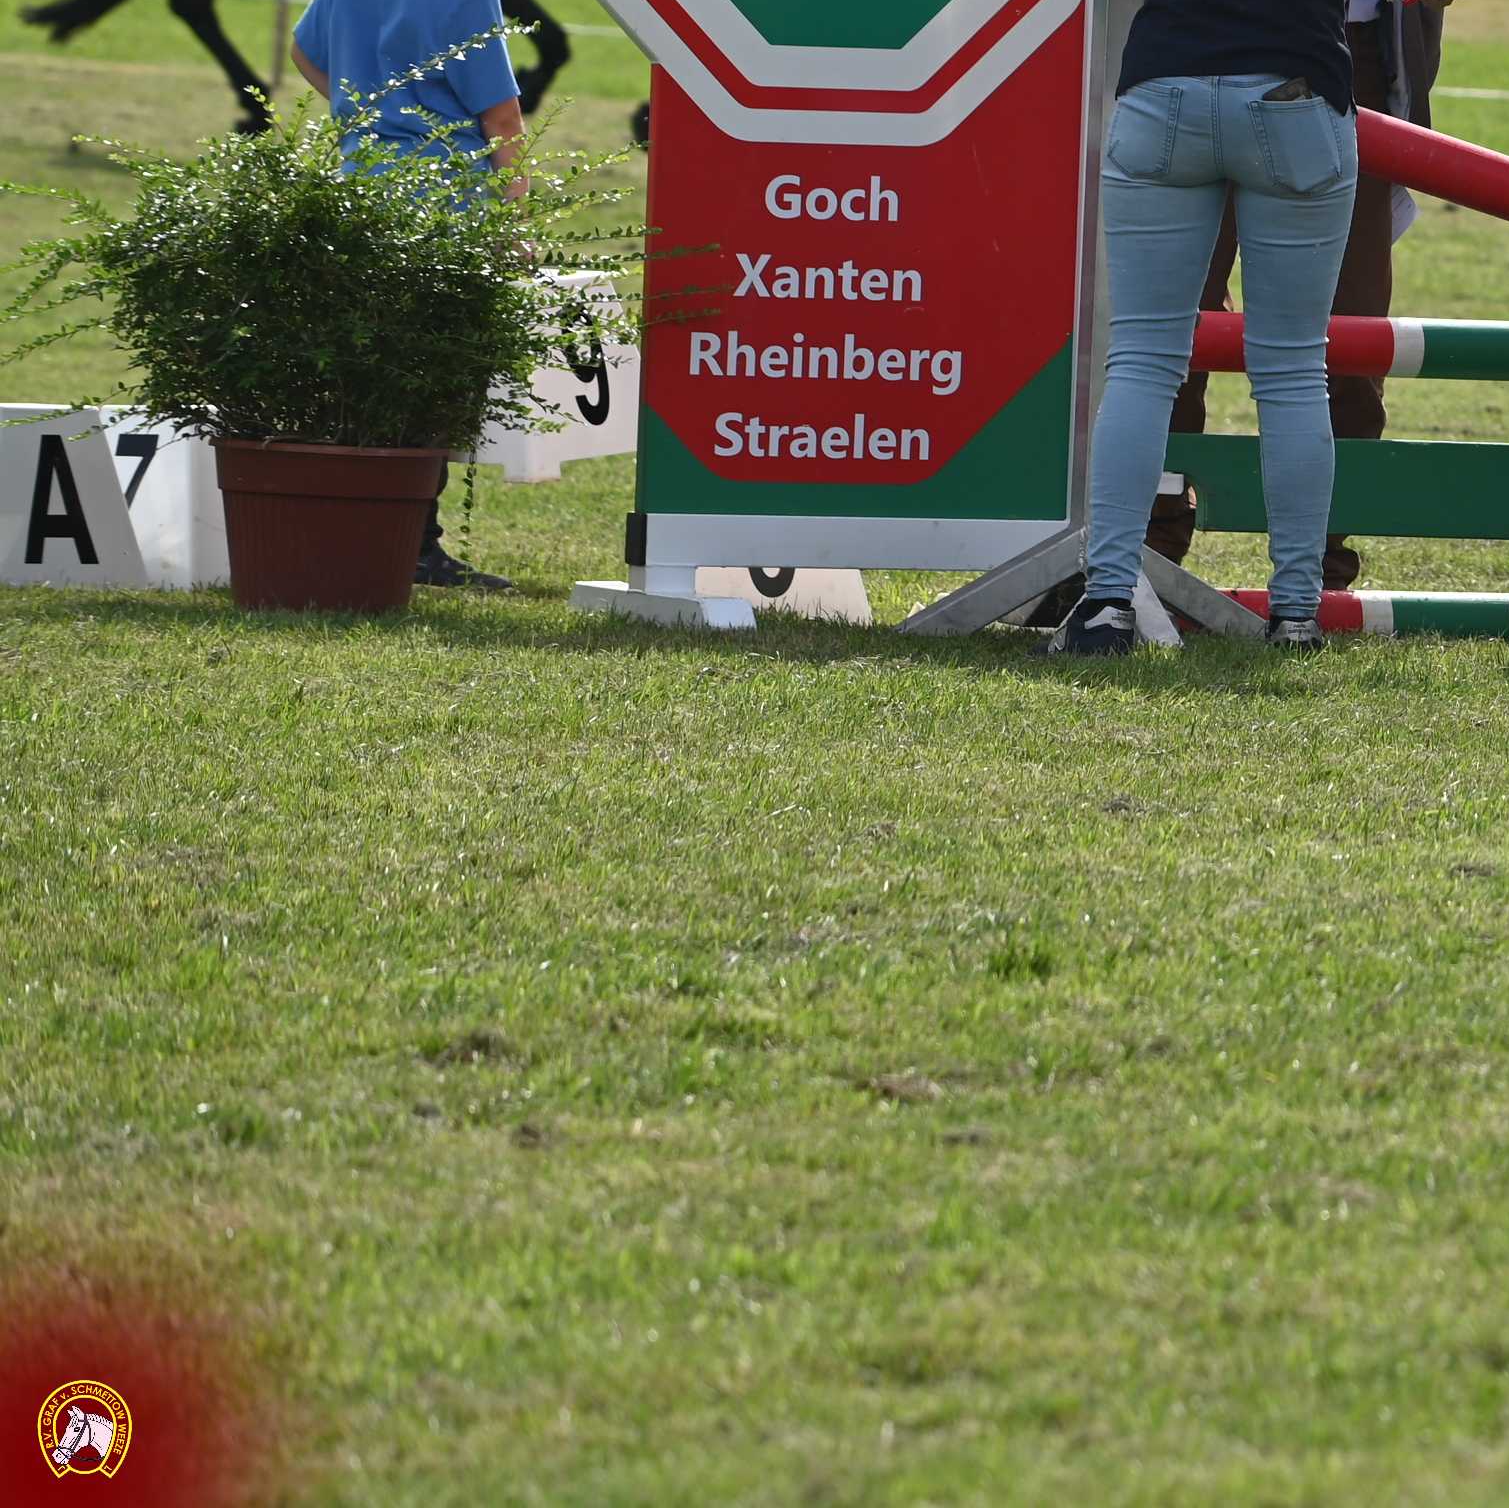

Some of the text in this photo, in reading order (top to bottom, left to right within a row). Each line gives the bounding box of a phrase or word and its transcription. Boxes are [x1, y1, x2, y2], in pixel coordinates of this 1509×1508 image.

[764, 174, 899, 222] Goch
[732, 253, 923, 302] Xanten
[689, 331, 963, 395] Rheinberg
[713, 412, 931, 461] Straelen
[25, 434, 99, 564] A
[115, 434, 159, 509] 7
